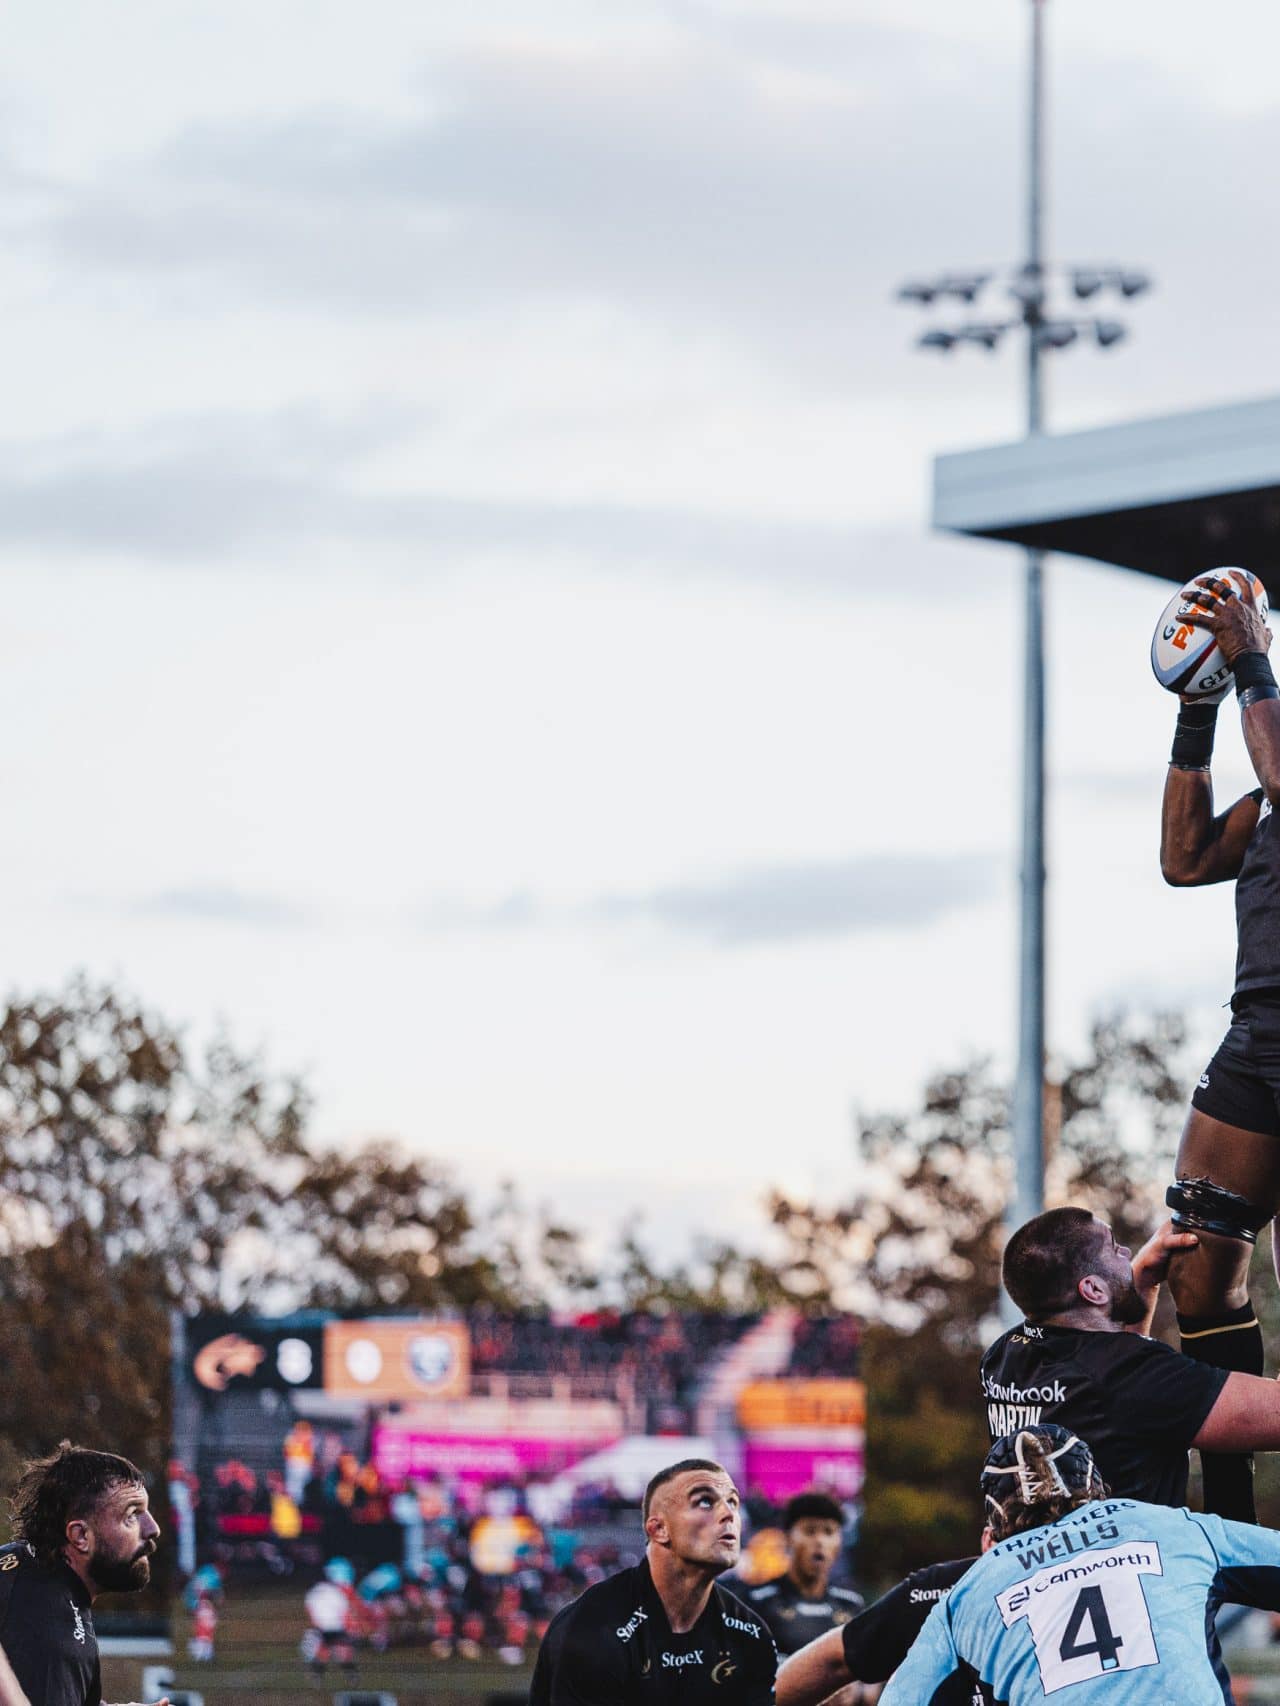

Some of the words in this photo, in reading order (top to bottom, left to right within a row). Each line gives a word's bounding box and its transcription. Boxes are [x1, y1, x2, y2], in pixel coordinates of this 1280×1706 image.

[1015, 1519, 1119, 1571] WELLS
[909, 1584, 955, 1604] Stone
[1058, 1584, 1124, 1672] 4
